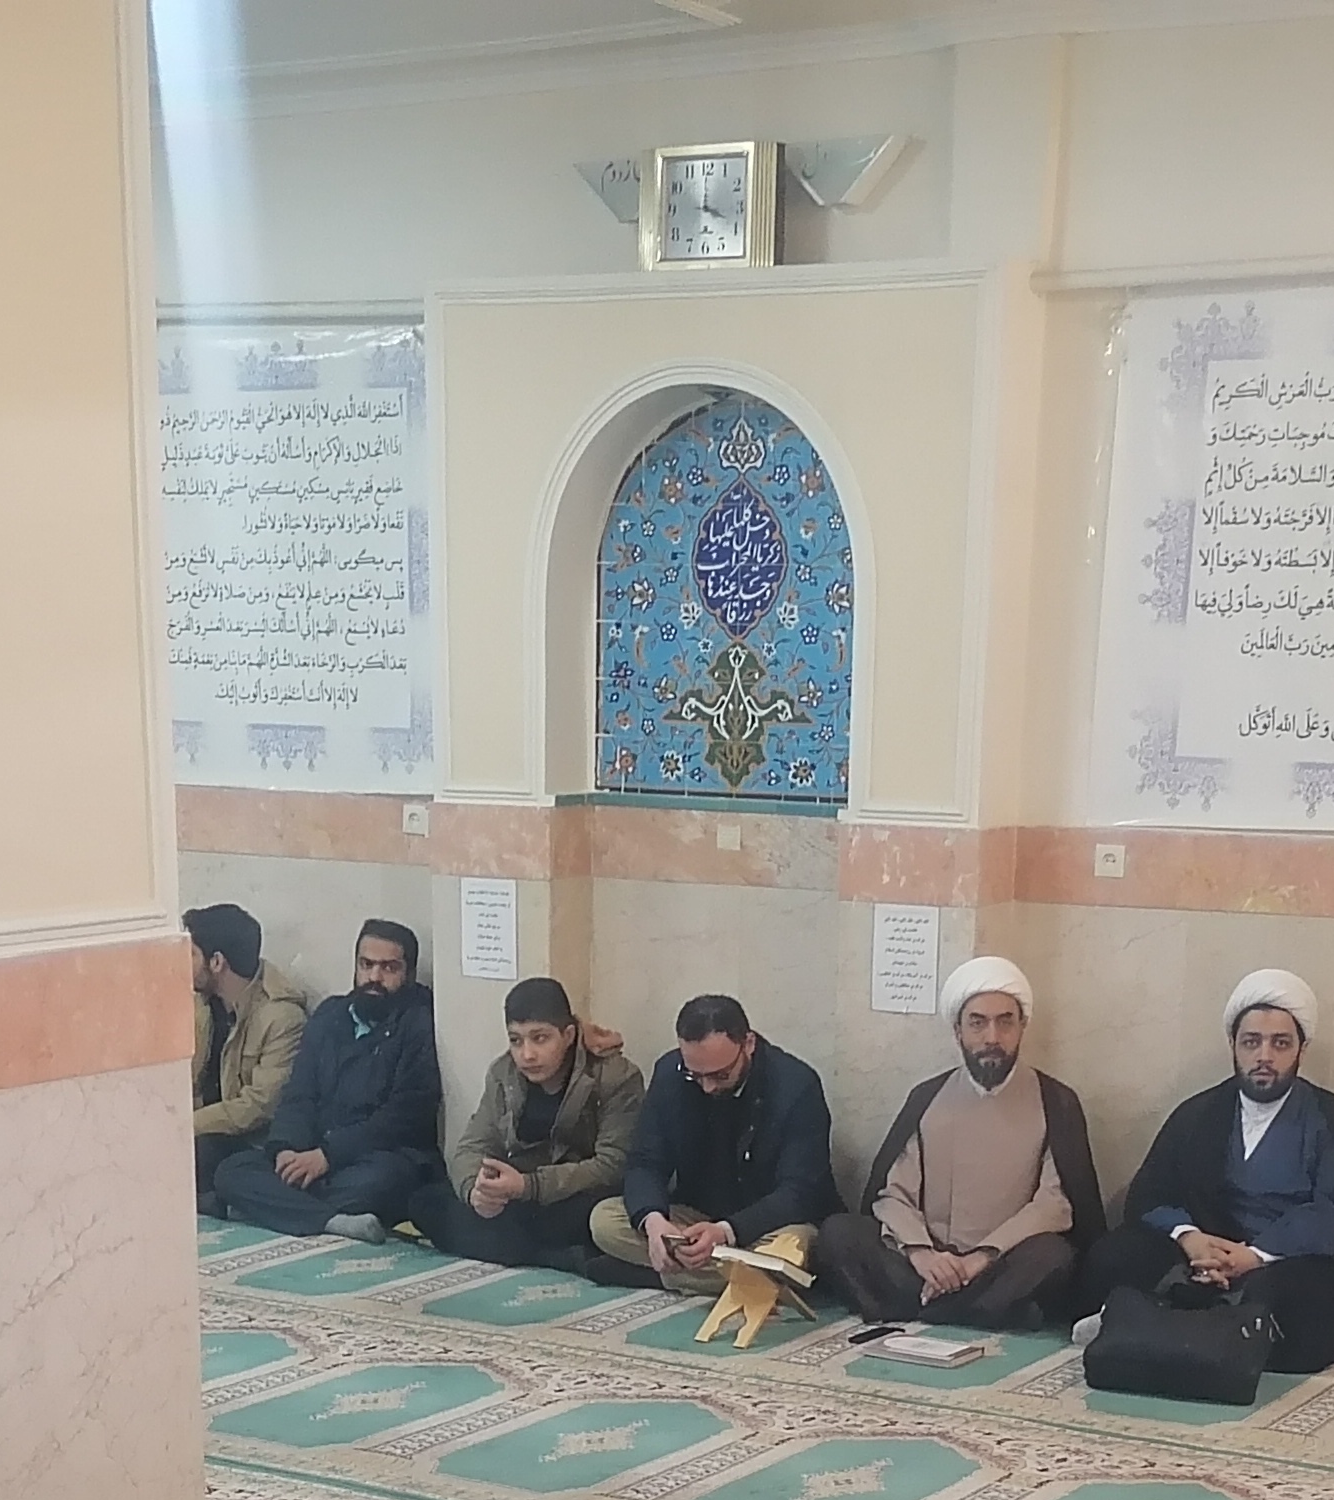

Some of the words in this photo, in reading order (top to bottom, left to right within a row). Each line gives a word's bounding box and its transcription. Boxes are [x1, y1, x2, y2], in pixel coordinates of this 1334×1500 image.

[685, 164, 695, 180] 11
[701, 161, 715, 177] 12
[722, 162, 728, 178] 1
[671, 180, 683, 195] 10
[733, 177, 742, 193] 2
[671, 226, 680, 242] 8
[686, 238, 694, 254] 7
[701, 241, 710, 255] 6
[717, 236, 726, 251] 5
